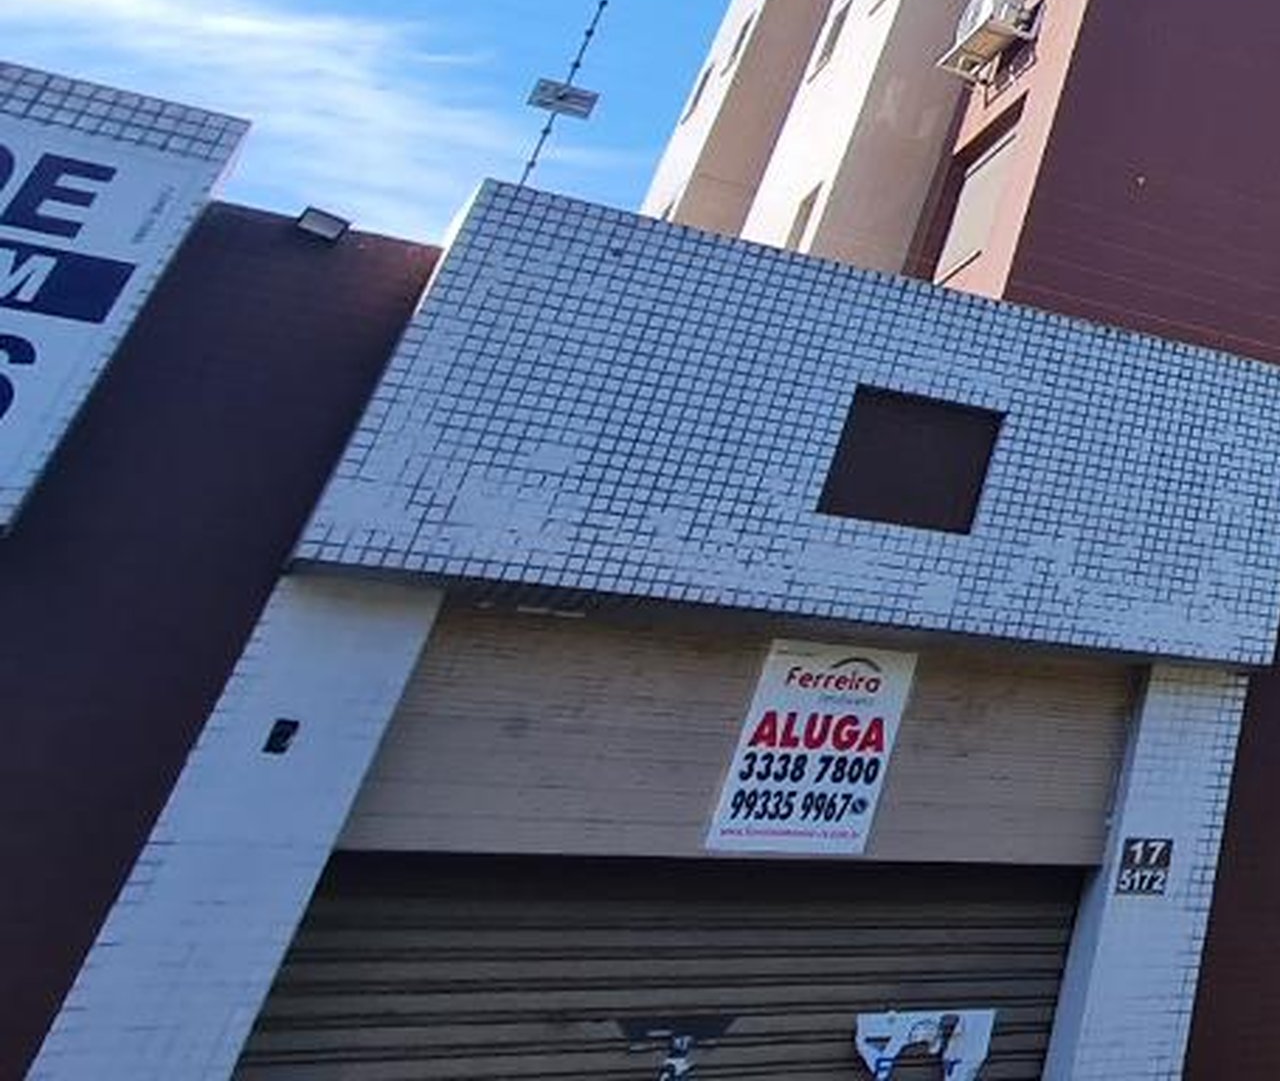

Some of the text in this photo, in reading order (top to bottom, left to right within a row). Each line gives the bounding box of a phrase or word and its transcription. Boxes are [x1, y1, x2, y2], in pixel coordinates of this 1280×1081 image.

[787, 666, 881, 693] Ferreira
[748, 709, 885, 752] ALUGA
[739, 752, 880, 785] 3338 7800
[731, 788, 853, 822] 99335 9967
[1130, 841, 1165, 864] 17
[1119, 868, 1165, 890] 5172
